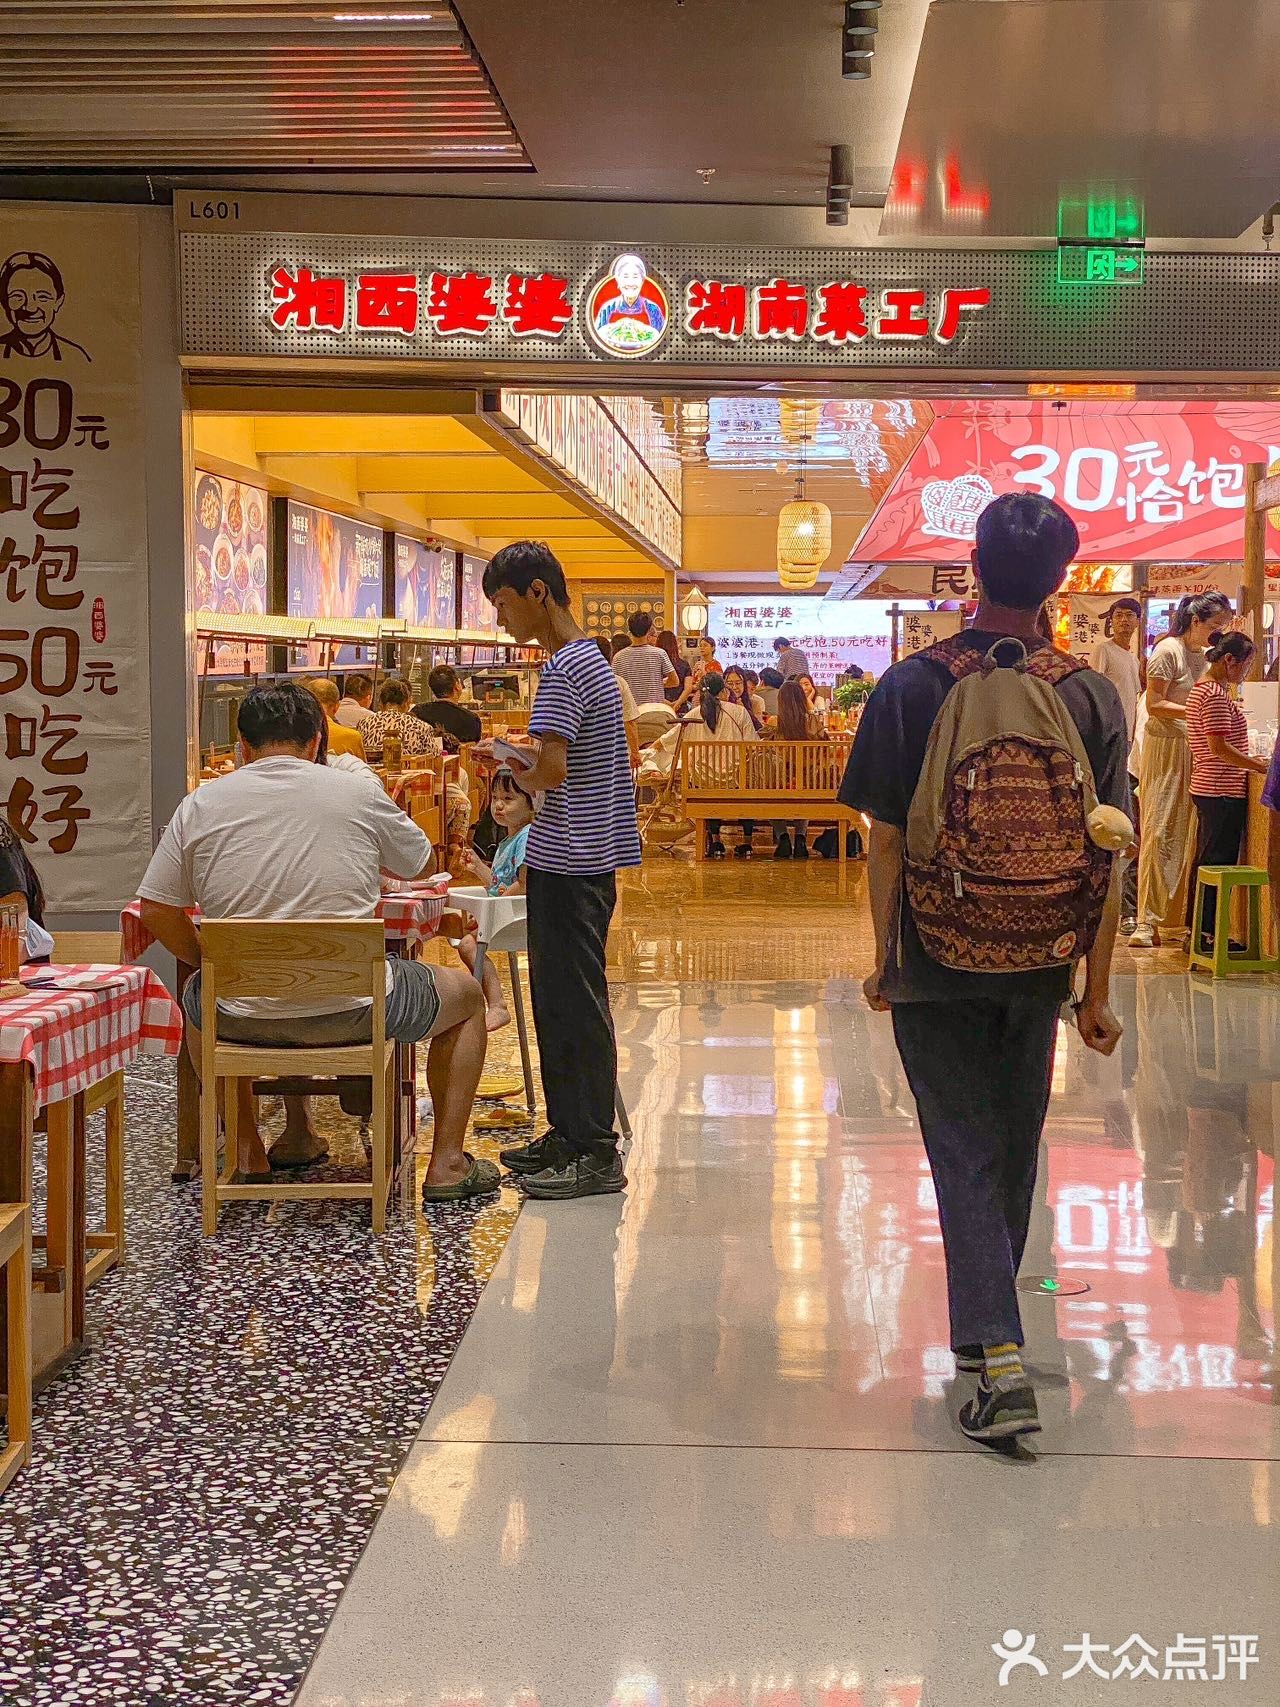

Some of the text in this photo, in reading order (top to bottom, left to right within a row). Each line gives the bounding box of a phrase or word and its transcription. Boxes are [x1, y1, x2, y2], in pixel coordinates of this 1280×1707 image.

[189, 203, 241, 220] L601
[270, 267, 574, 337] 湘西婆婆
[685, 278, 990, 345] 湖南菜工厂
[724, 607, 793, 619] 湘西婆婆
